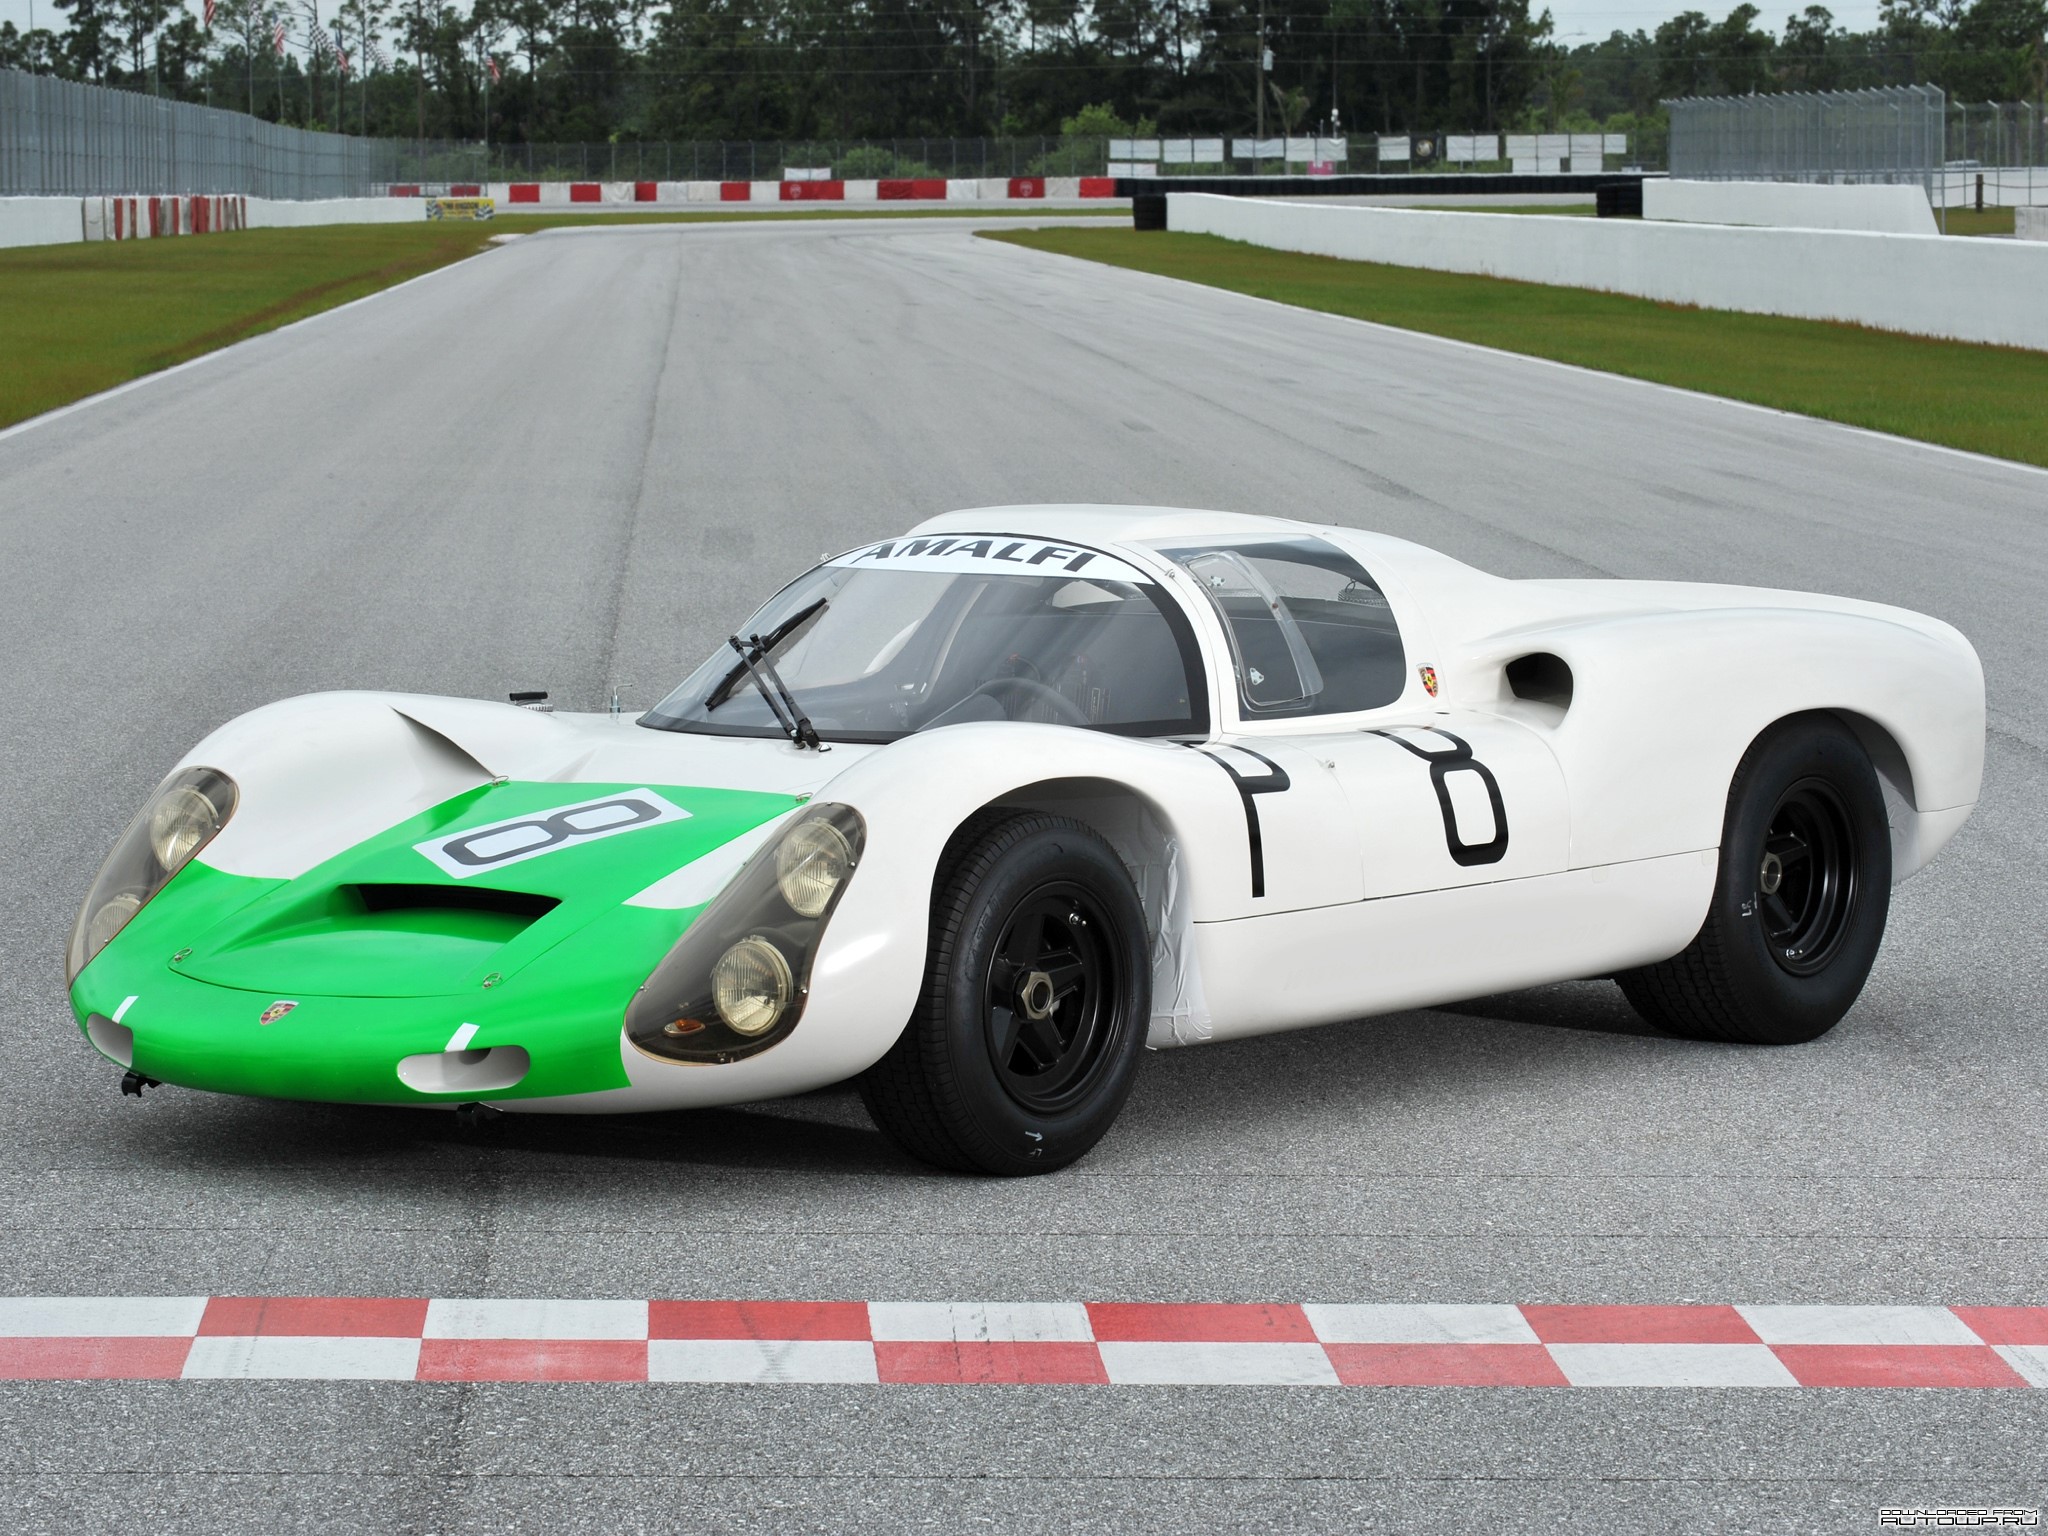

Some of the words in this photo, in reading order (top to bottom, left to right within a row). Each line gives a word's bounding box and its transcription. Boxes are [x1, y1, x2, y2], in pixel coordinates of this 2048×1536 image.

[850, 539, 1097, 572] AMALFI
[1361, 725, 1509, 867] 8
[443, 799, 662, 866] 8
